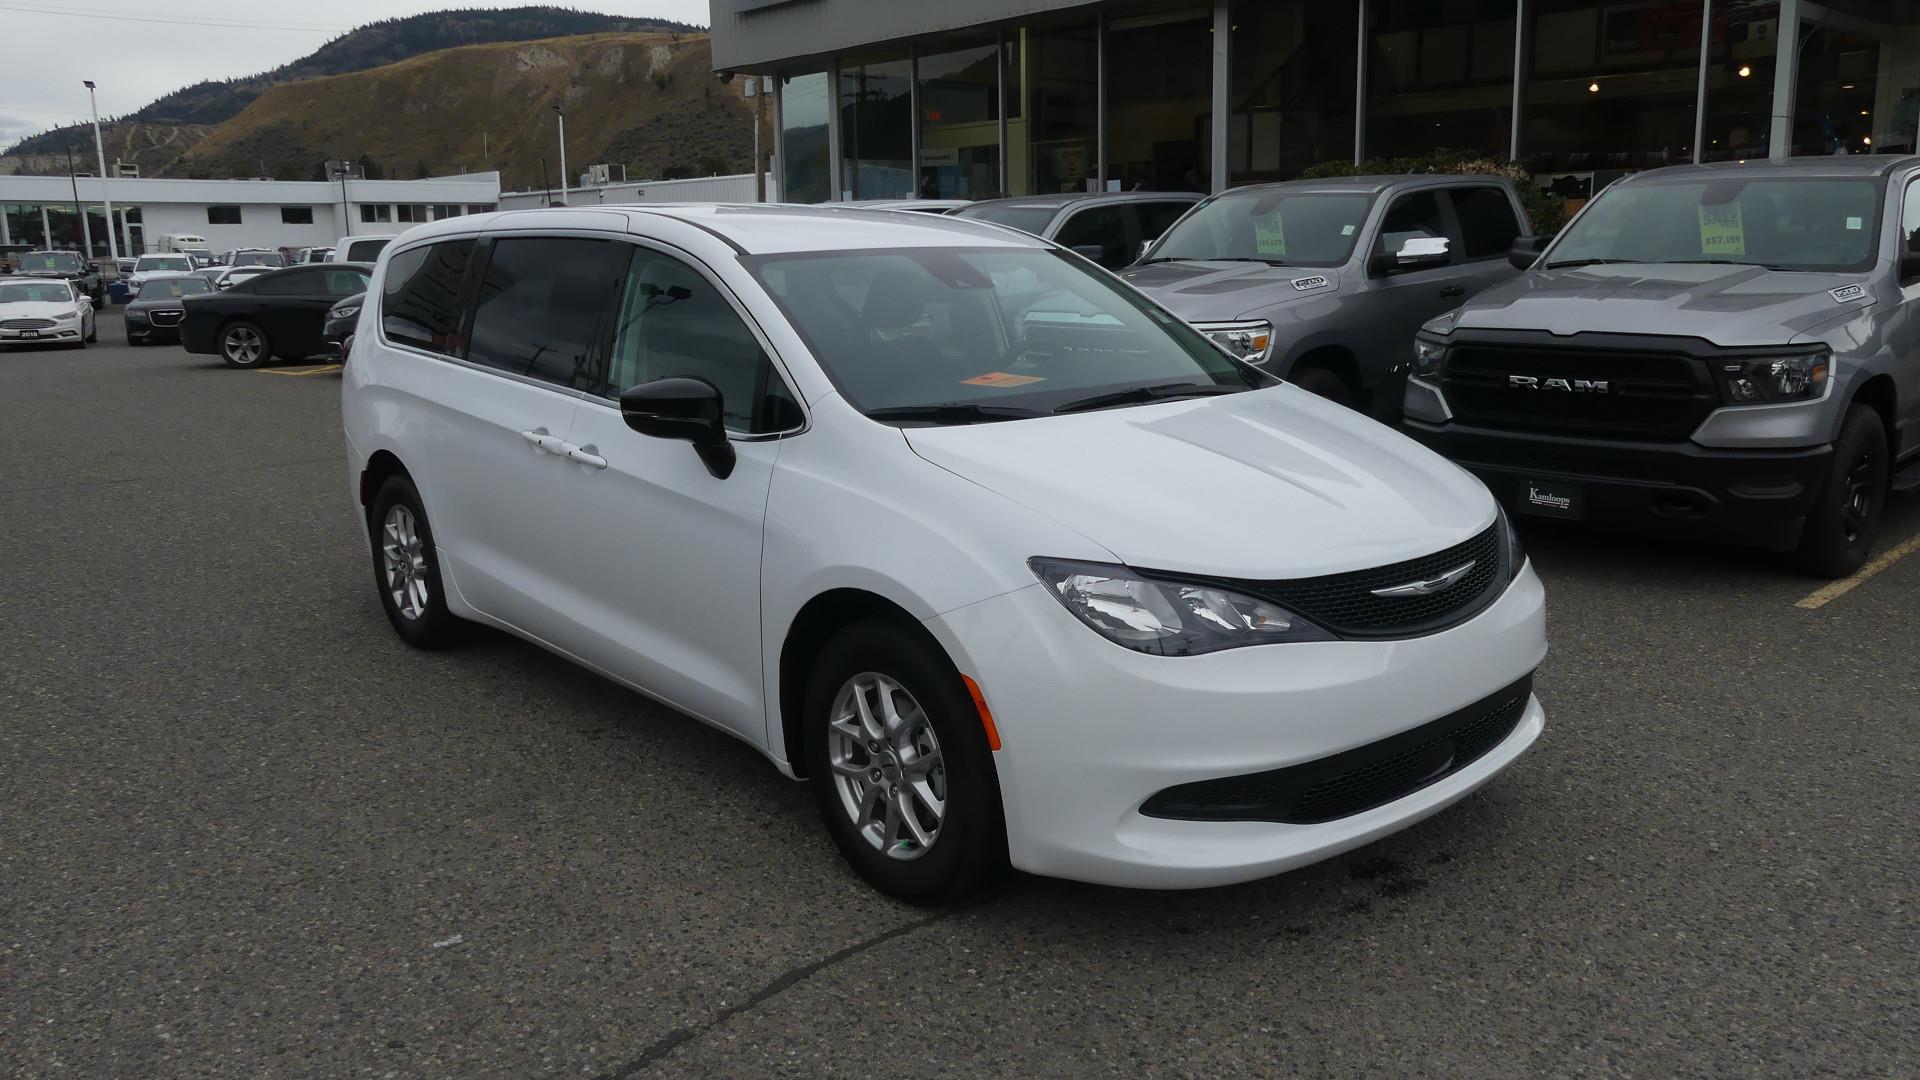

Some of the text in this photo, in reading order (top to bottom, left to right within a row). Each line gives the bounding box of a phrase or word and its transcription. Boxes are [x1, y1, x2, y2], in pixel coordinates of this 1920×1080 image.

[1834, 286, 1860, 297] 1500
[1509, 375, 1608, 393] RAM
[1530, 487, 1570, 506] Kamloops
